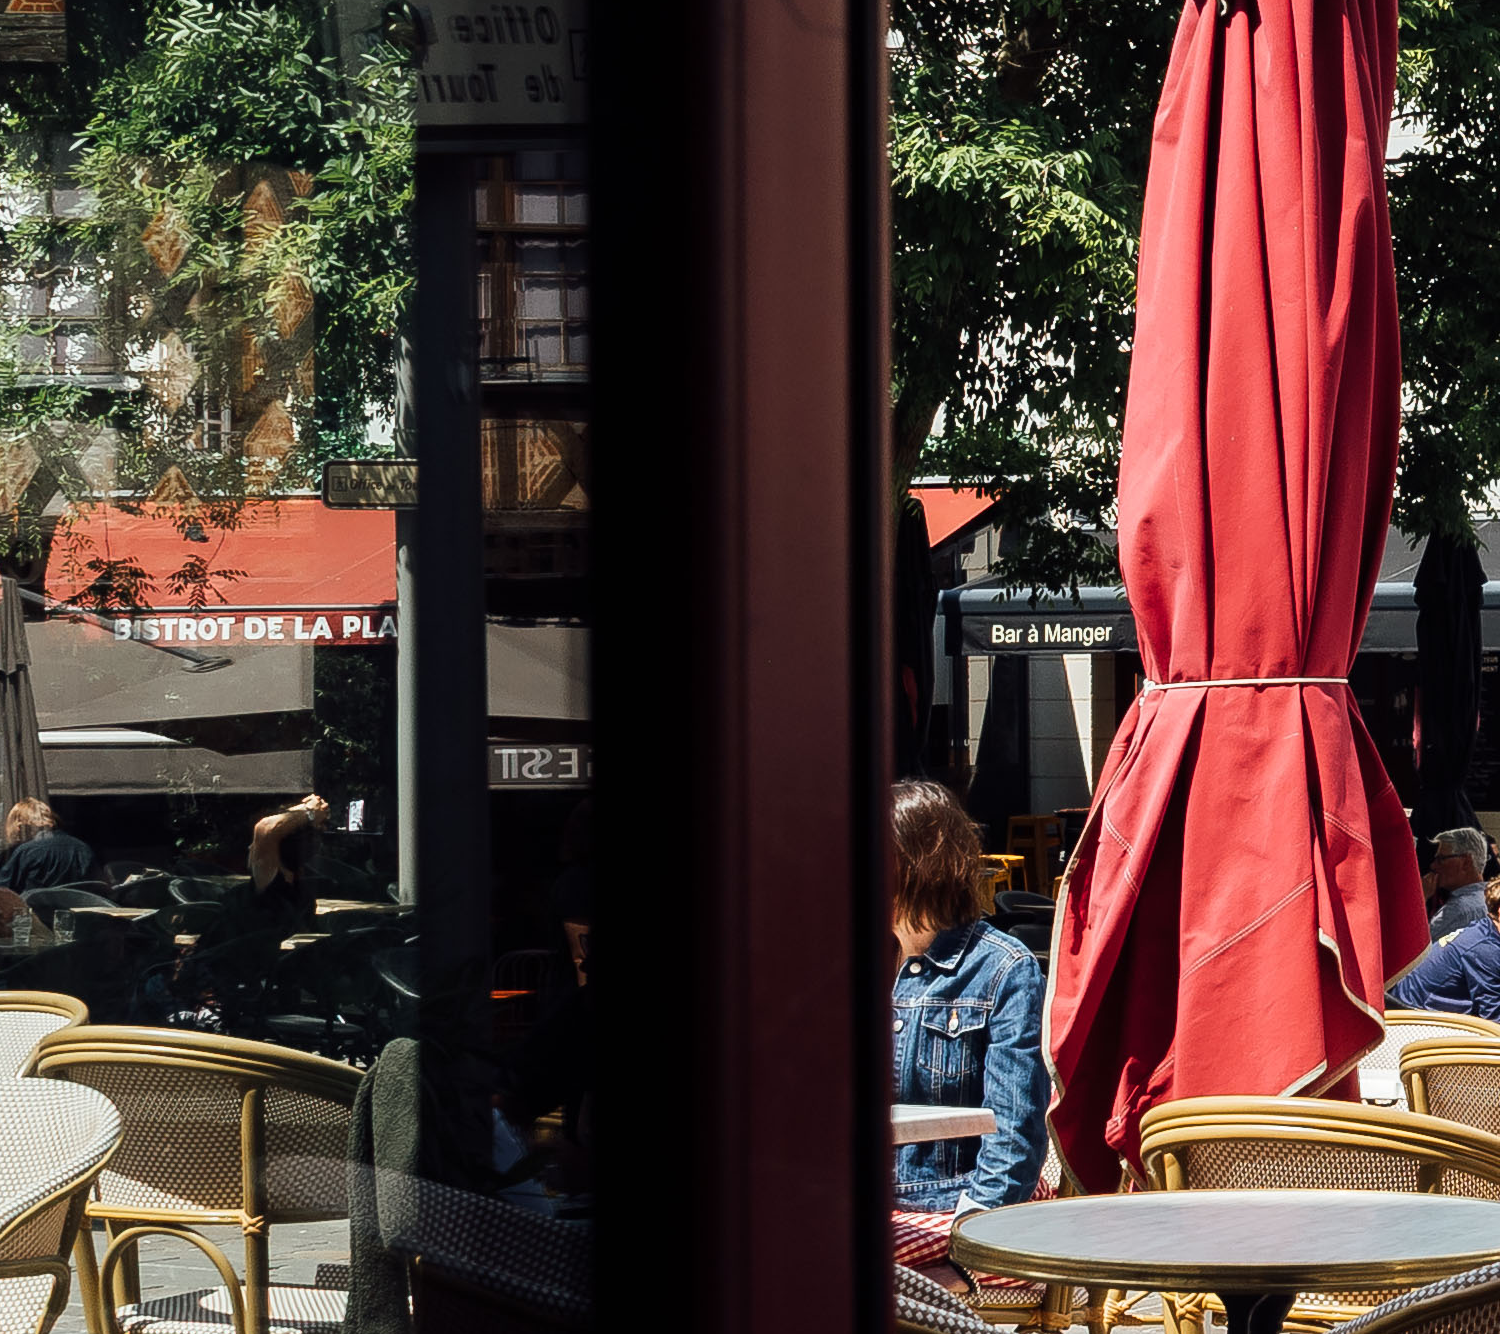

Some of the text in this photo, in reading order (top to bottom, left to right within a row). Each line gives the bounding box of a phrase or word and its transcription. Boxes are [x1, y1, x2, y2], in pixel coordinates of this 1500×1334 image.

[114, 617, 235, 640] BISTROT
[243, 617, 284, 640] DE
[294, 617, 332, 640] LA
[991, 623, 1113, 646] Bar à Manger
